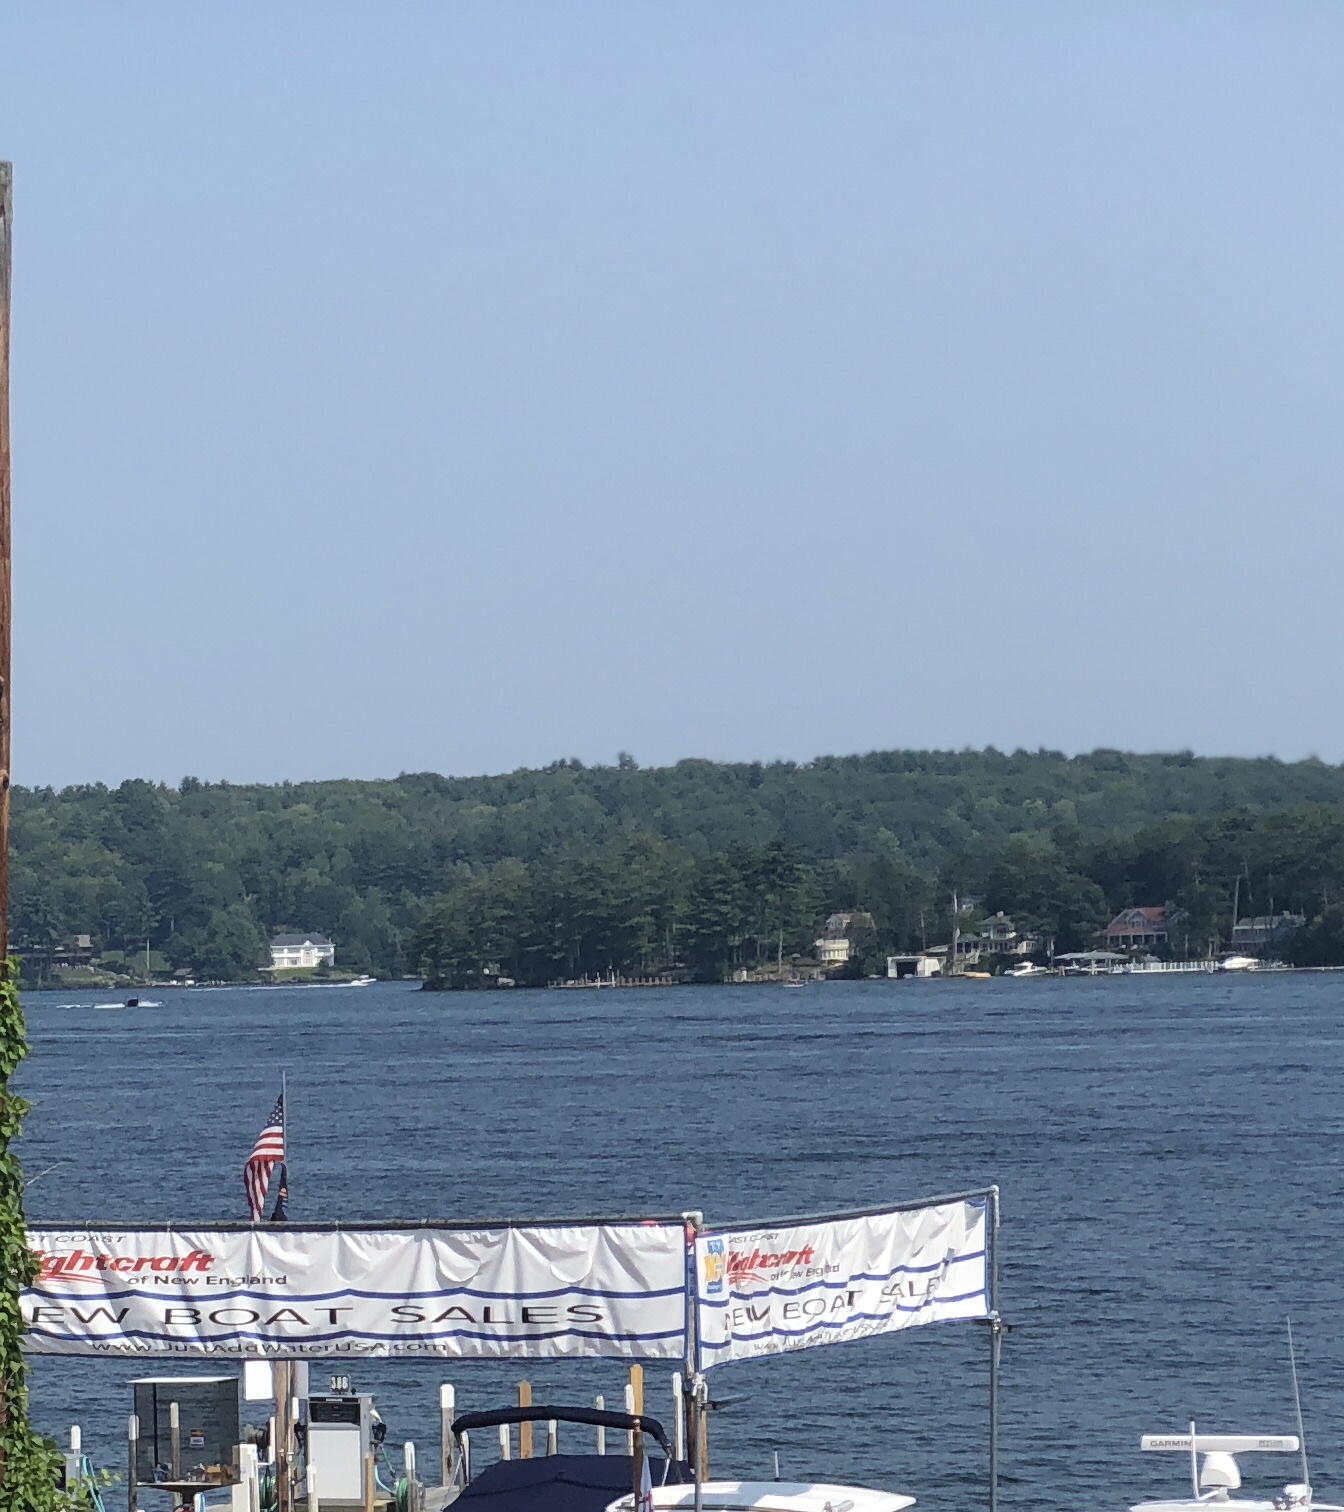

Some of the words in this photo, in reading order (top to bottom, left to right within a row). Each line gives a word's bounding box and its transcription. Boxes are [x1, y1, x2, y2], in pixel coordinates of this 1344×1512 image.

[54, 1233, 127, 1244] COAST
[127, 1274, 150, 1285] of
[154, 1275, 200, 1285] New
[205, 1274, 288, 1289] England
[782, 1290, 863, 1321] BOAT
[31, 1306, 131, 1325] EW
[164, 1306, 355, 1326] BOAT
[390, 1304, 606, 1325] SALES
